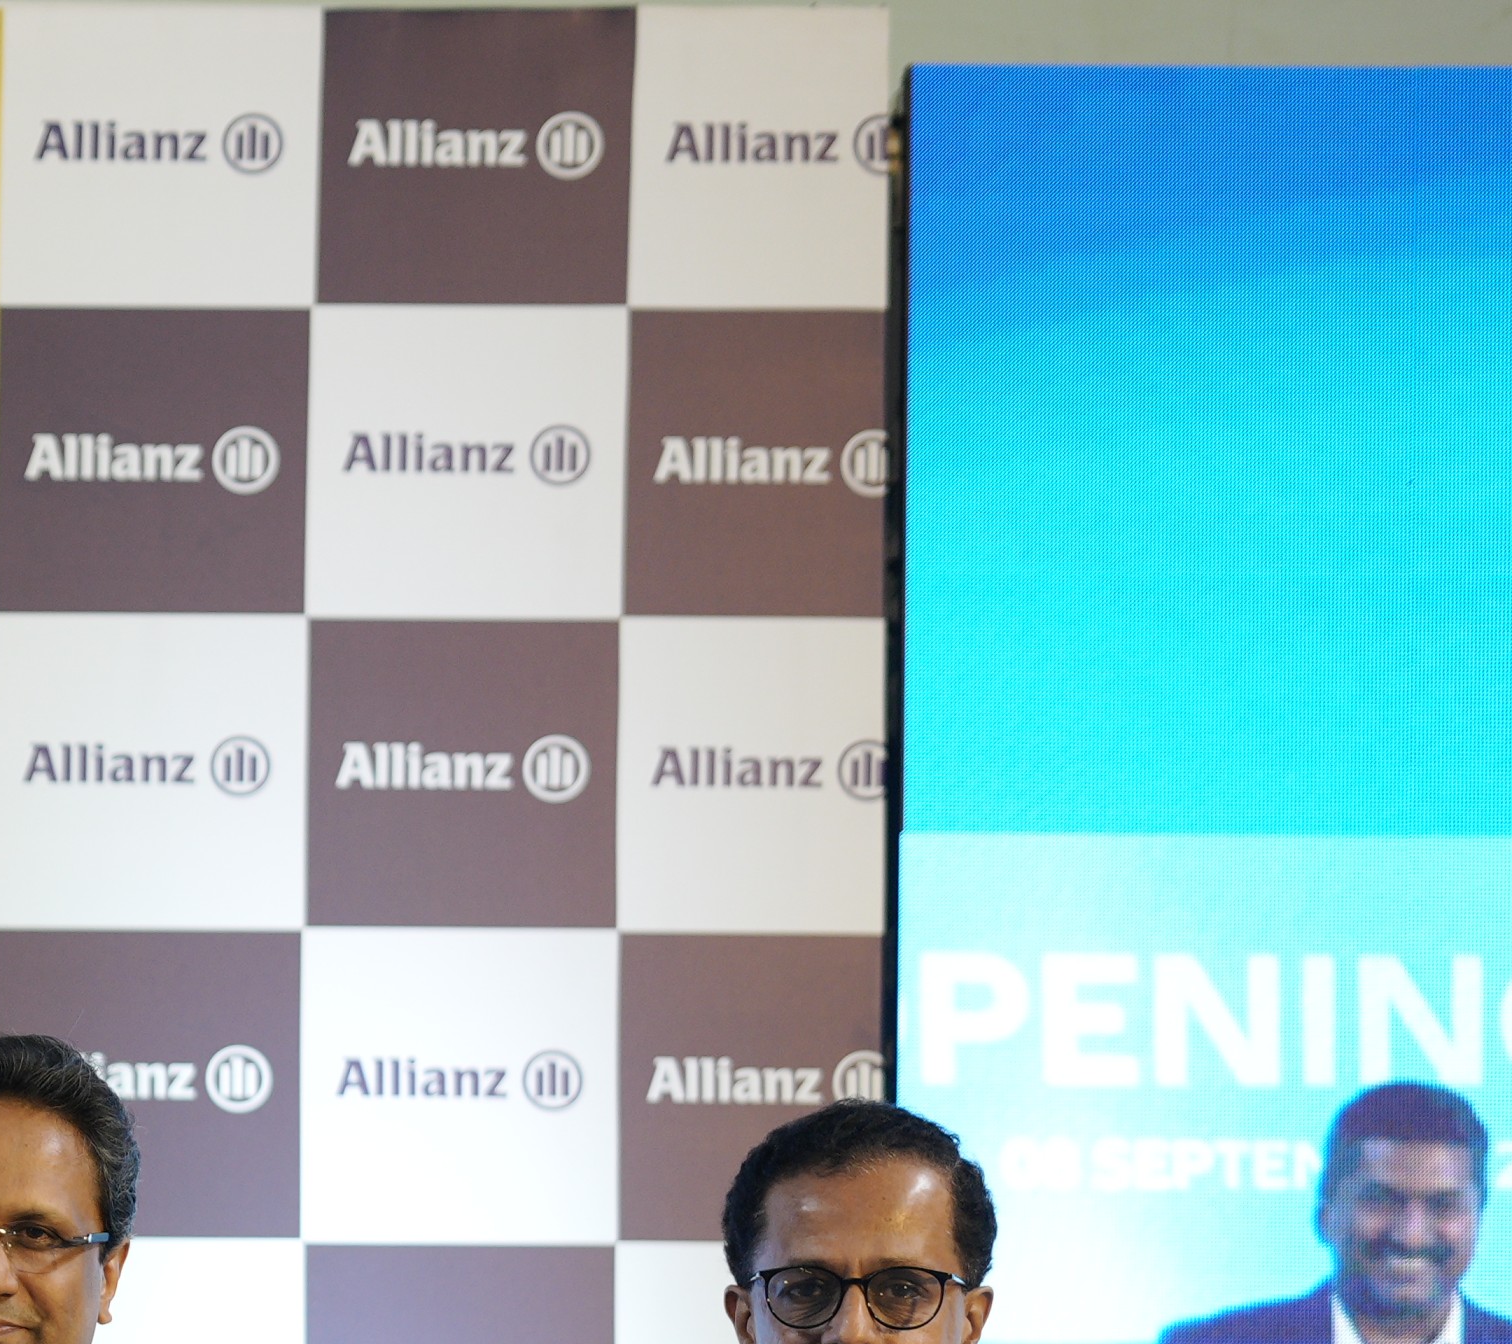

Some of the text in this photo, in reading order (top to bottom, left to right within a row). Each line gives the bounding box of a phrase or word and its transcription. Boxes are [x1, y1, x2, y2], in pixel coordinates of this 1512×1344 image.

[34, 121, 207, 164] Allianz
[347, 119, 527, 168] Allianz
[666, 121, 839, 165] Allianz
[24, 433, 204, 483] Allianz
[343, 433, 515, 475] Allianz
[654, 436, 830, 485] Allianz
[23, 744, 196, 787] Allianz
[335, 742, 513, 791] Allianz
[651, 747, 824, 789] Allianz
[898, 950, 1512, 1089] PENIN
[336, 1056, 507, 1097] Allianz
[647, 1055, 822, 1105] Allianz
